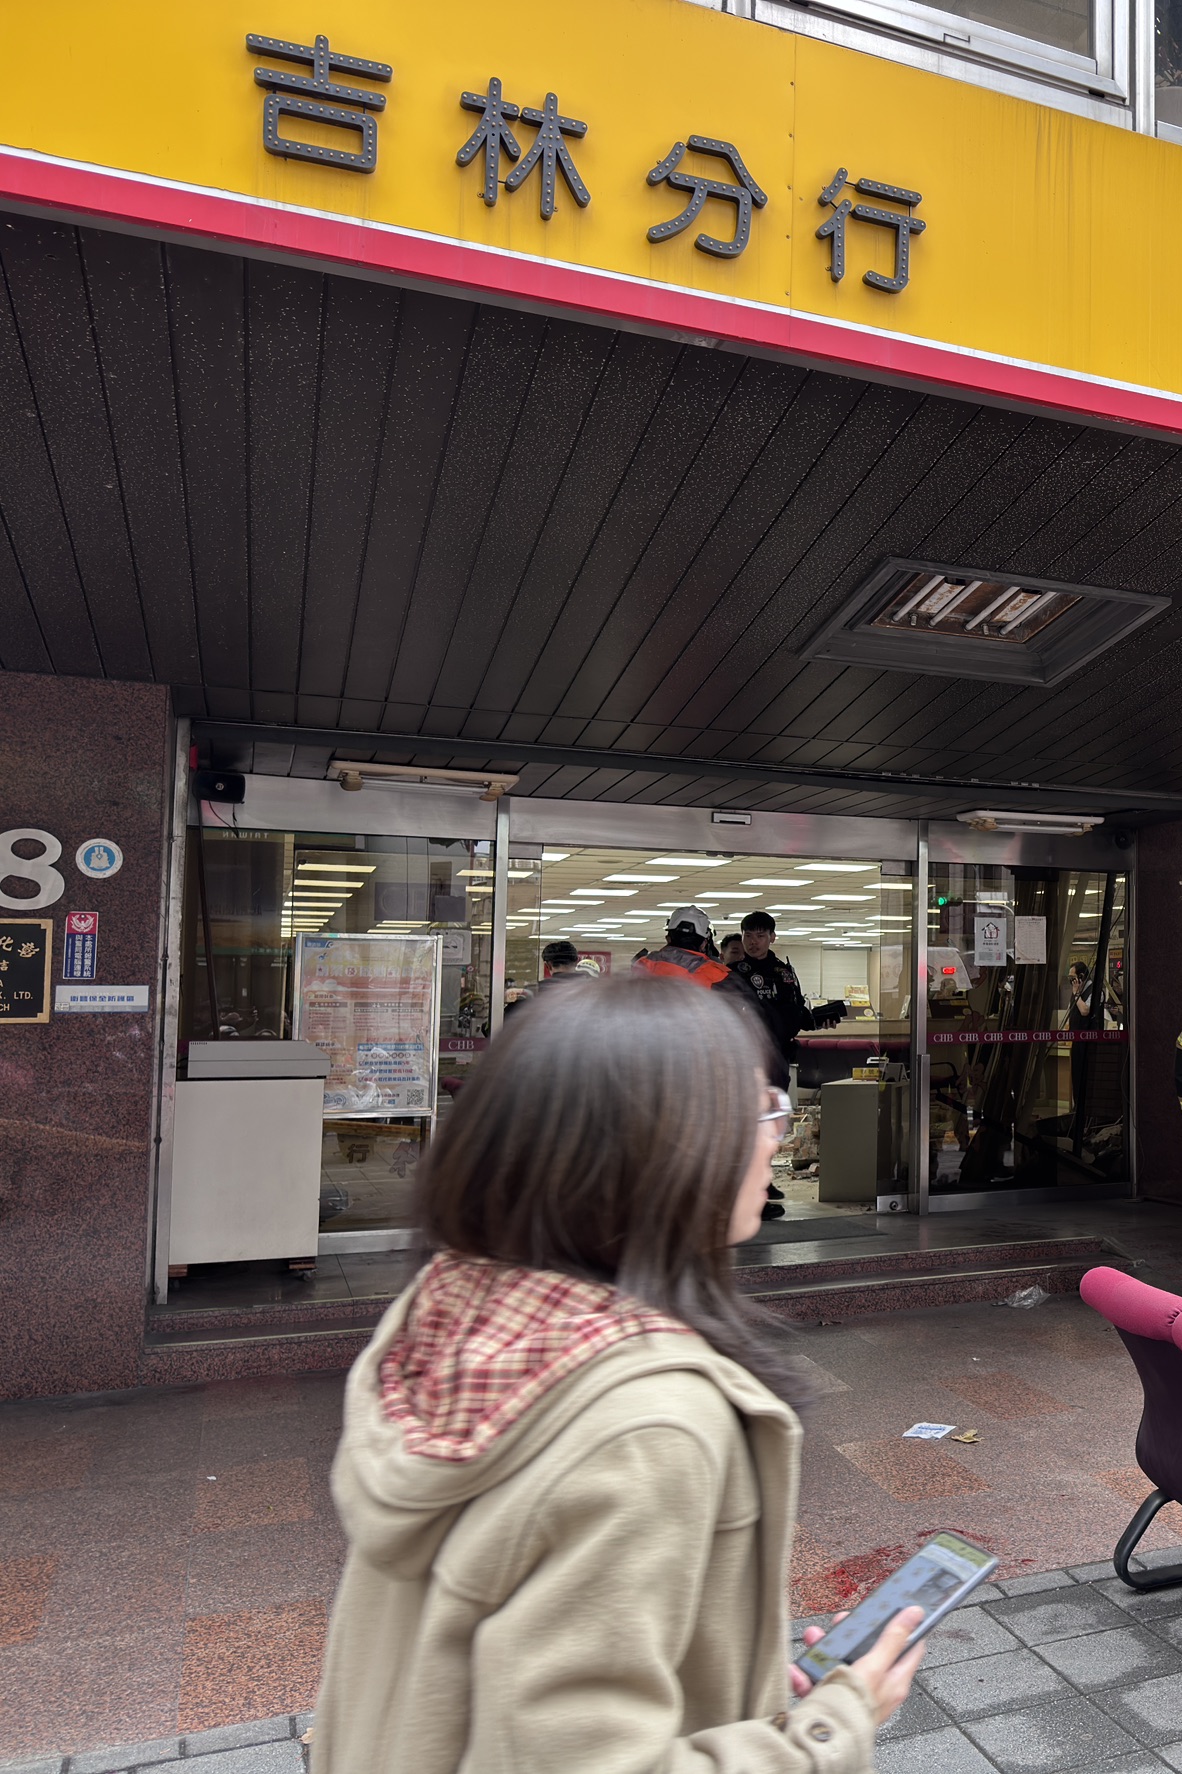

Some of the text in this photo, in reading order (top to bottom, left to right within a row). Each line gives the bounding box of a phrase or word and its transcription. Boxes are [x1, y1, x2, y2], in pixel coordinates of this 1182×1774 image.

[245, 33, 927, 295] 吉林分行
[14, 991, 34, 1000] LTD.
[448, 1040, 475, 1050] CHB
[933, 1034, 953, 1043] CHB
[959, 1033, 979, 1042] CHB
[984, 1033, 1003, 1042] CHB
[1008, 1032, 1028, 1041] CHB
[1033, 1032, 1051, 1041] CHB
[1056, 1031, 1075, 1040] CHB
[1079, 1031, 1098, 1040] CHB
